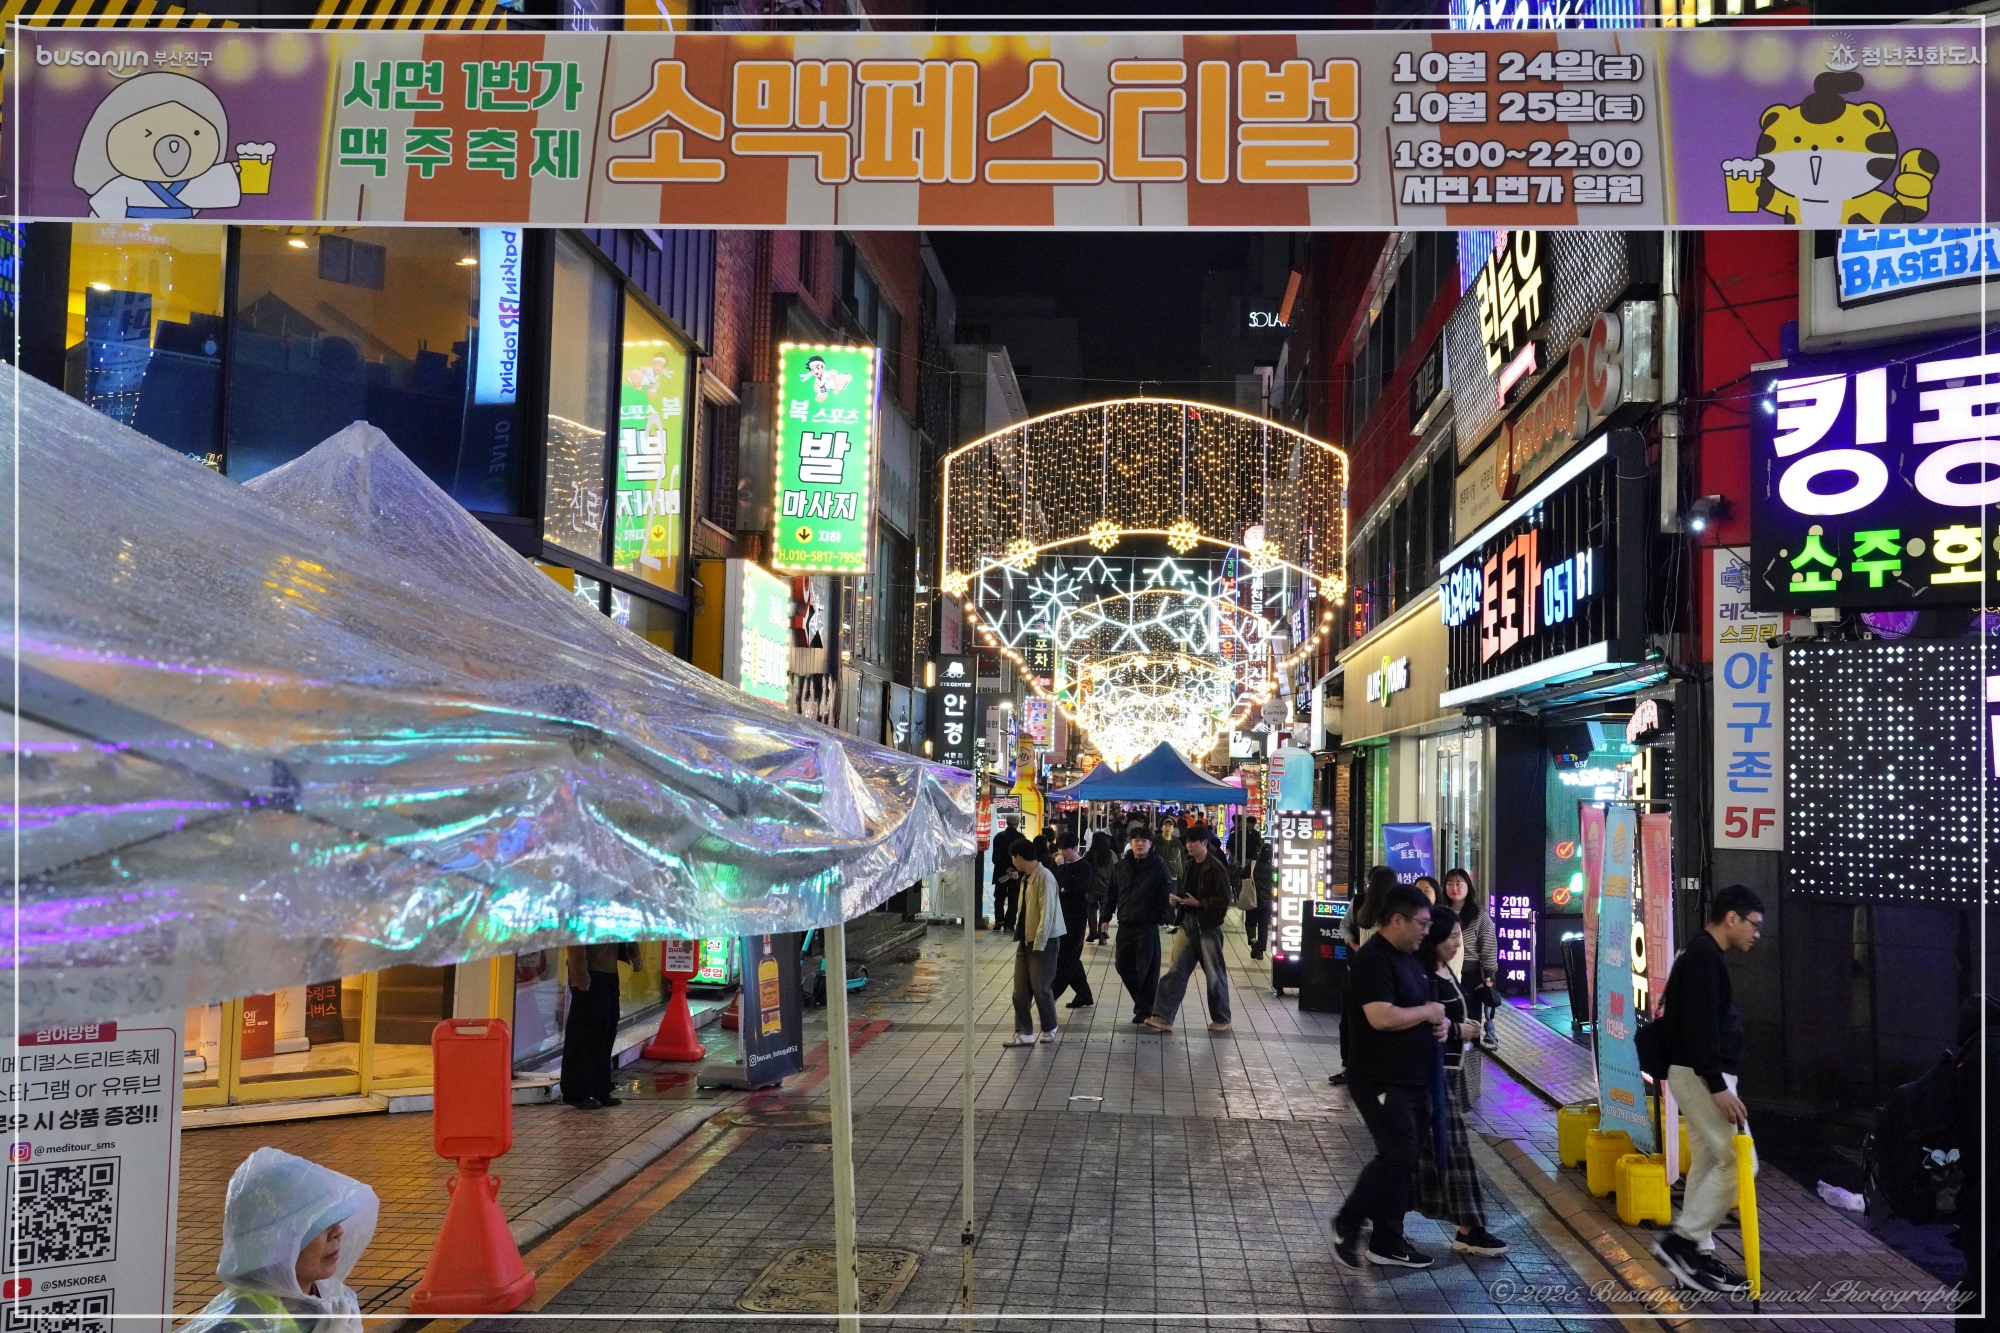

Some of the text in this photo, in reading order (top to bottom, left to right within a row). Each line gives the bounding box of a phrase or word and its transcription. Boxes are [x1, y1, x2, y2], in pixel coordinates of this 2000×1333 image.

[36, 45, 213, 72] busanjin 부산진구
[1392, 50, 1644, 84] 10월 24일(금)
[1861, 45, 1988, 68] 청년친화도시
[342, 58, 584, 112] 서면 1번가
[606, 57, 1361, 184] 소맥페스티벌
[1392, 91, 1644, 124] 10월 25일(토)
[1394, 139, 1642, 169] 18:00~22:00
[1401, 175, 1643, 204] 서면1번가 일원
[1248, 311, 1289, 328] SOLA
[789, 399, 860, 425] 복 스포츠
[1773, 352, 2000, 516] 킹콩
[798, 431, 851, 485] 발
[782, 490, 858, 520] 마사지
[818, 530, 842, 543] 지하
[779, 549, 862, 564] H.010-5817-7950
[1790, 529, 1901, 592] 소주
[1482, 529, 1541, 664] 토토가
[1543, 558, 1573, 626] 051
[1576, 548, 1593, 600] B1
[1720, 603, 1778, 620] 레전
[1720, 623, 1777, 643] 스크린
[944, 693, 967, 745] 안경
[1724, 651, 1774, 793] 야구존
[1281, 818, 1312, 839] 킹콩
[1725, 806, 1776, 839] 5F
[1281, 841, 1308, 952] 노래타운
[1314, 904, 1347, 915] 요리믹스
[1502, 896, 1529, 907] 2010
[1500, 908, 1531, 918] 뉴트로
[1512, 940, 1520, 950] &
[75, 1083, 97, 1098] or
[102, 1074, 161, 1097] 유튜브
[33, 1110, 54, 1131] 시
[60, 1107, 100, 1131] 상품
[104, 1104, 158, 1127] 증정!!
[34, 1140, 116, 1157] @meditour_sms
[40, 1274, 107, 1292] @SMSKOREA
